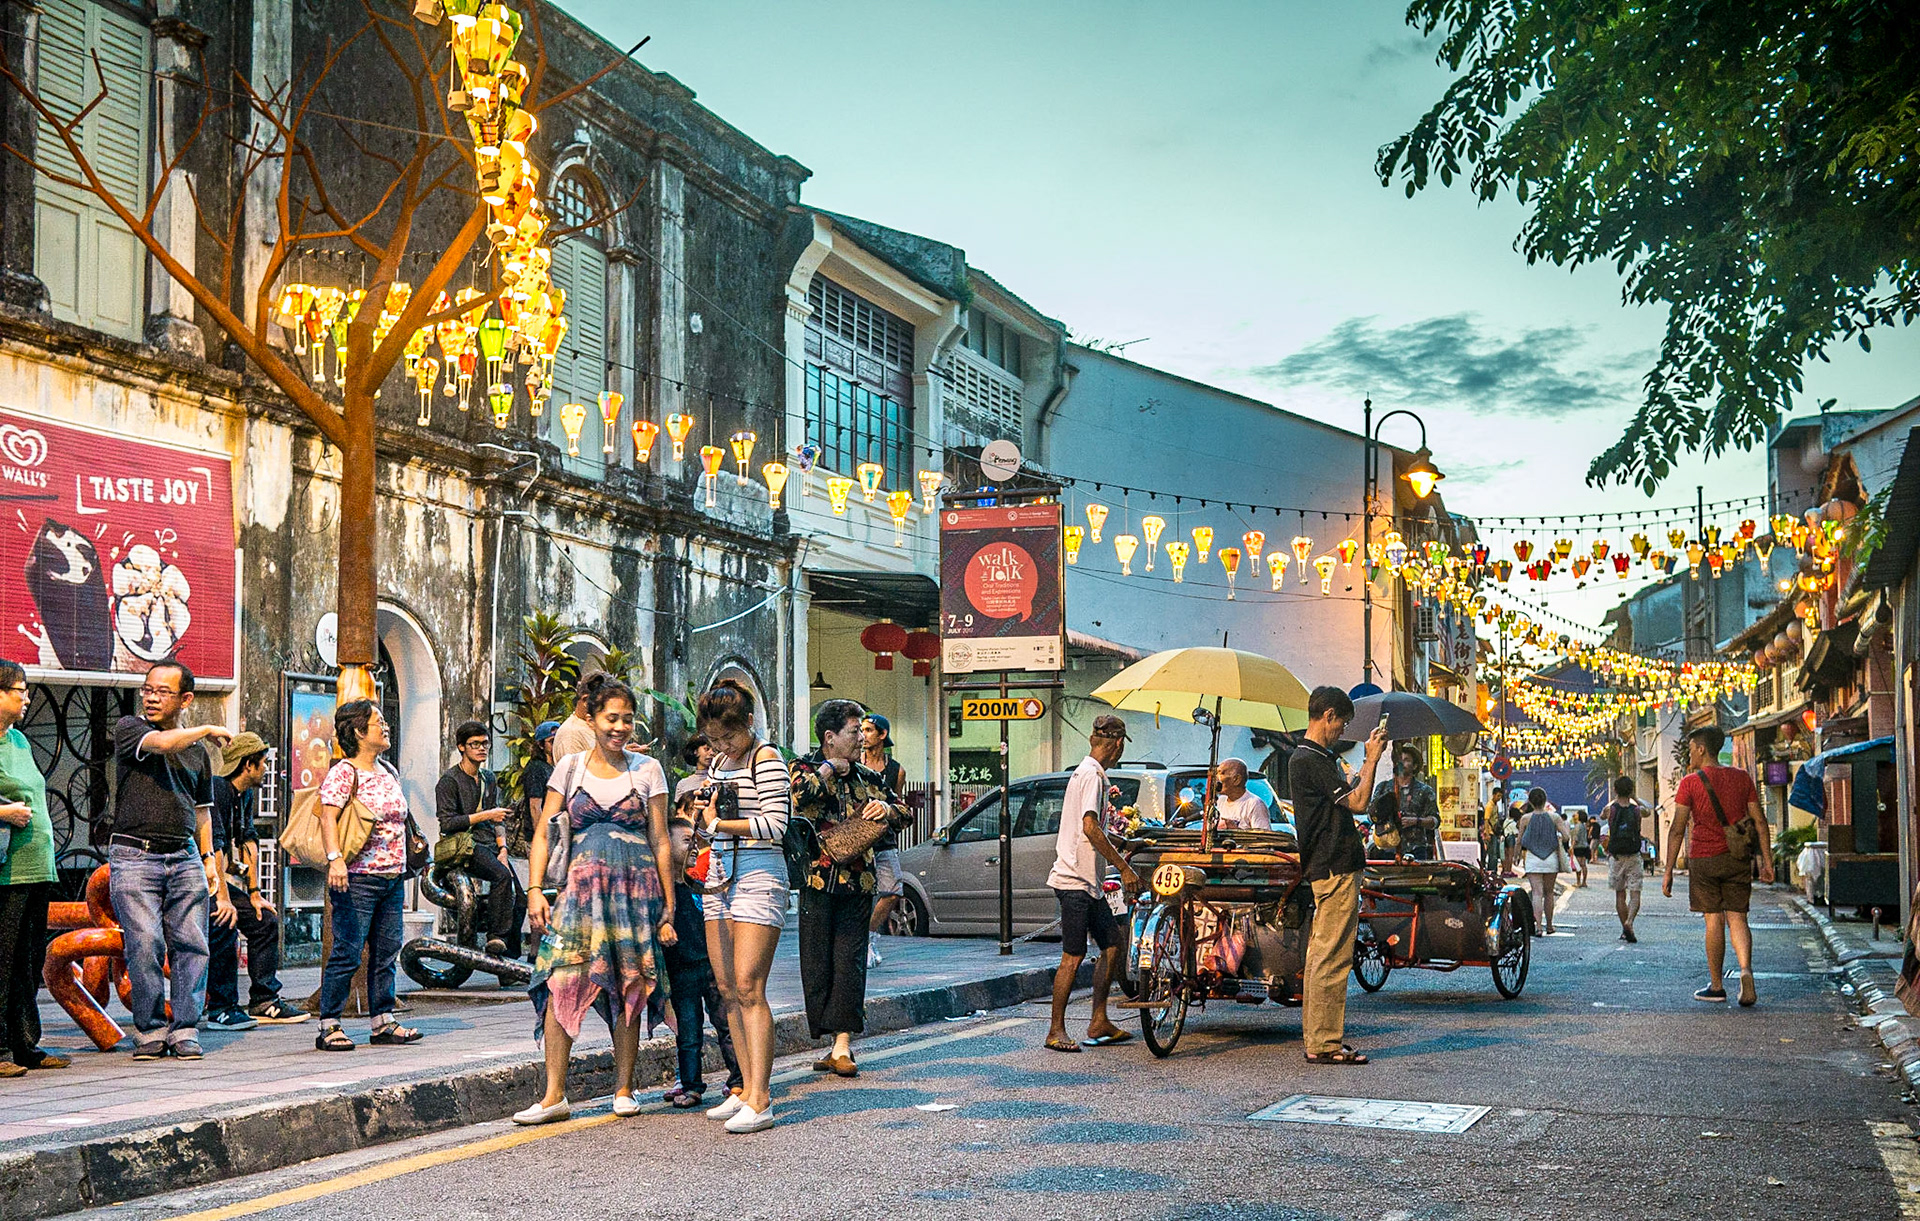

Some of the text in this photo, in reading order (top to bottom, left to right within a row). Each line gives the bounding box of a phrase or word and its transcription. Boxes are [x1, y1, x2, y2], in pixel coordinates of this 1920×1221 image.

[2, 464, 48, 488] WALL'S
[89, 476, 199, 505] TASTE JOY
[947, 627, 961, 635] JULY
[967, 702, 1018, 717] 200M
[1155, 871, 1180, 888] 493
